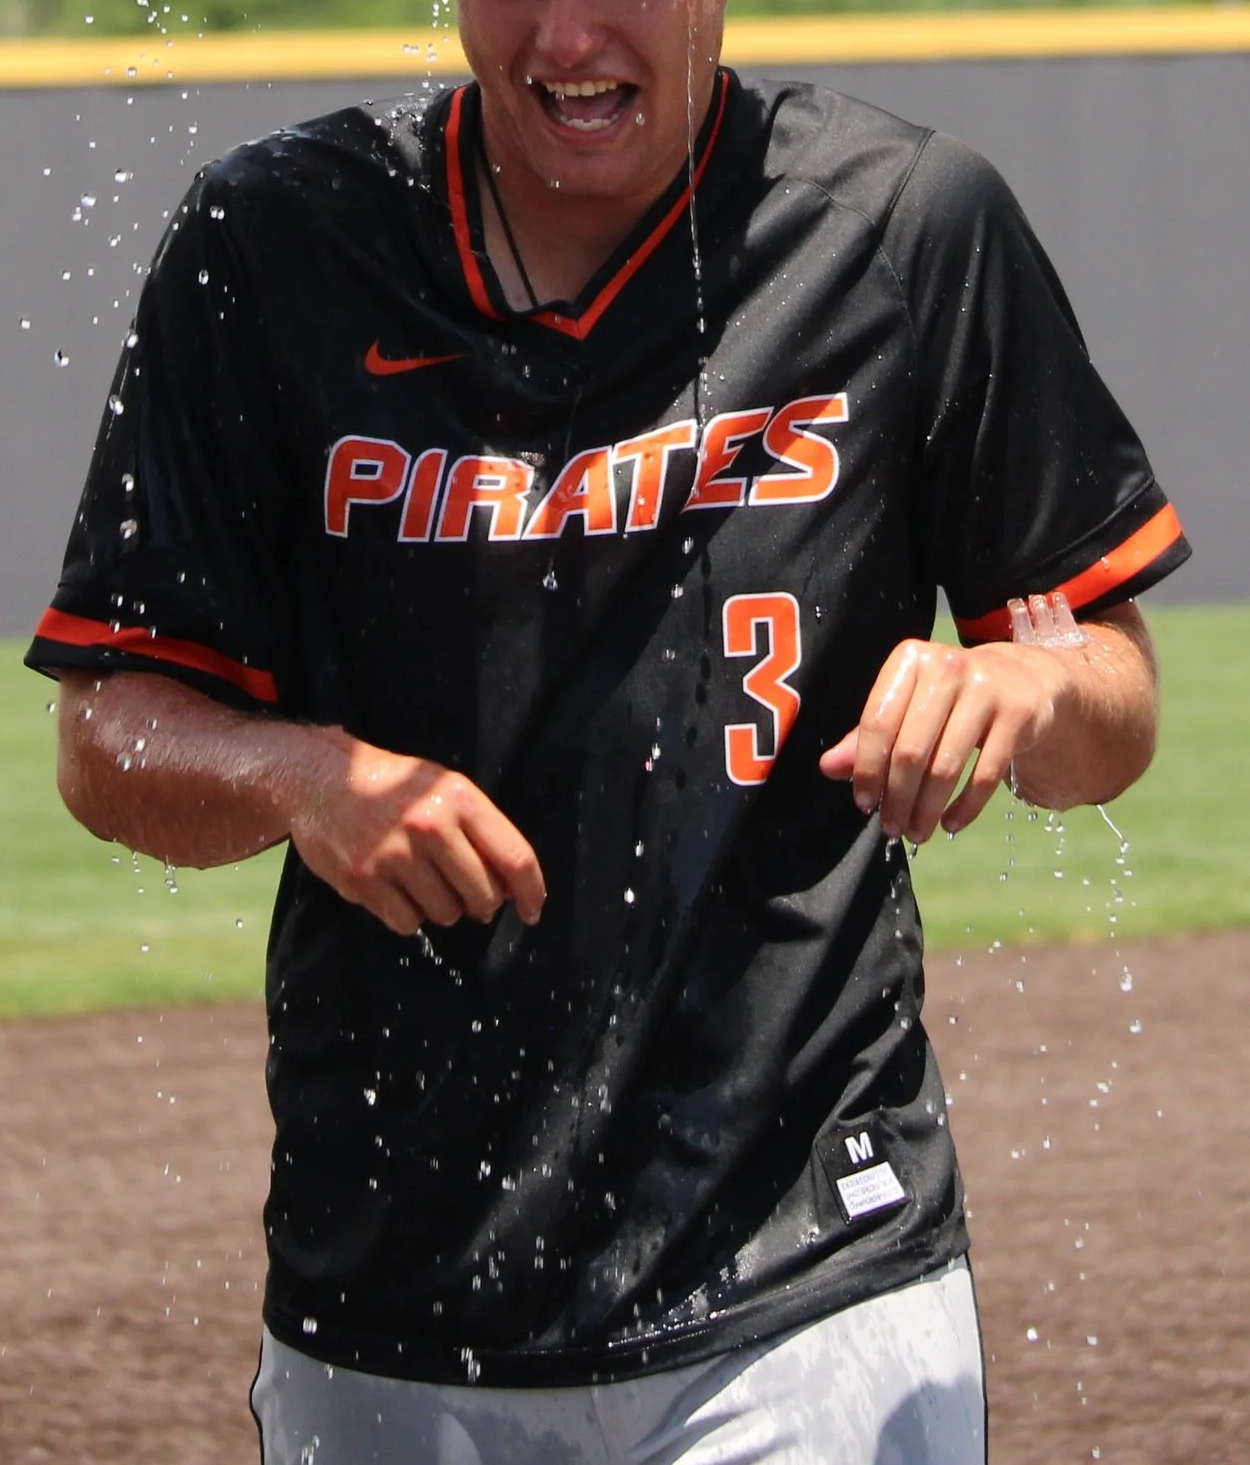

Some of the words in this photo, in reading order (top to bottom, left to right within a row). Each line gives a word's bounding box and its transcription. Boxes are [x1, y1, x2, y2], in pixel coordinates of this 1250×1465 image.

[323, 390, 850, 544] PIRATES
[721, 590, 803, 787] 3
[844, 1131, 874, 1165] M
